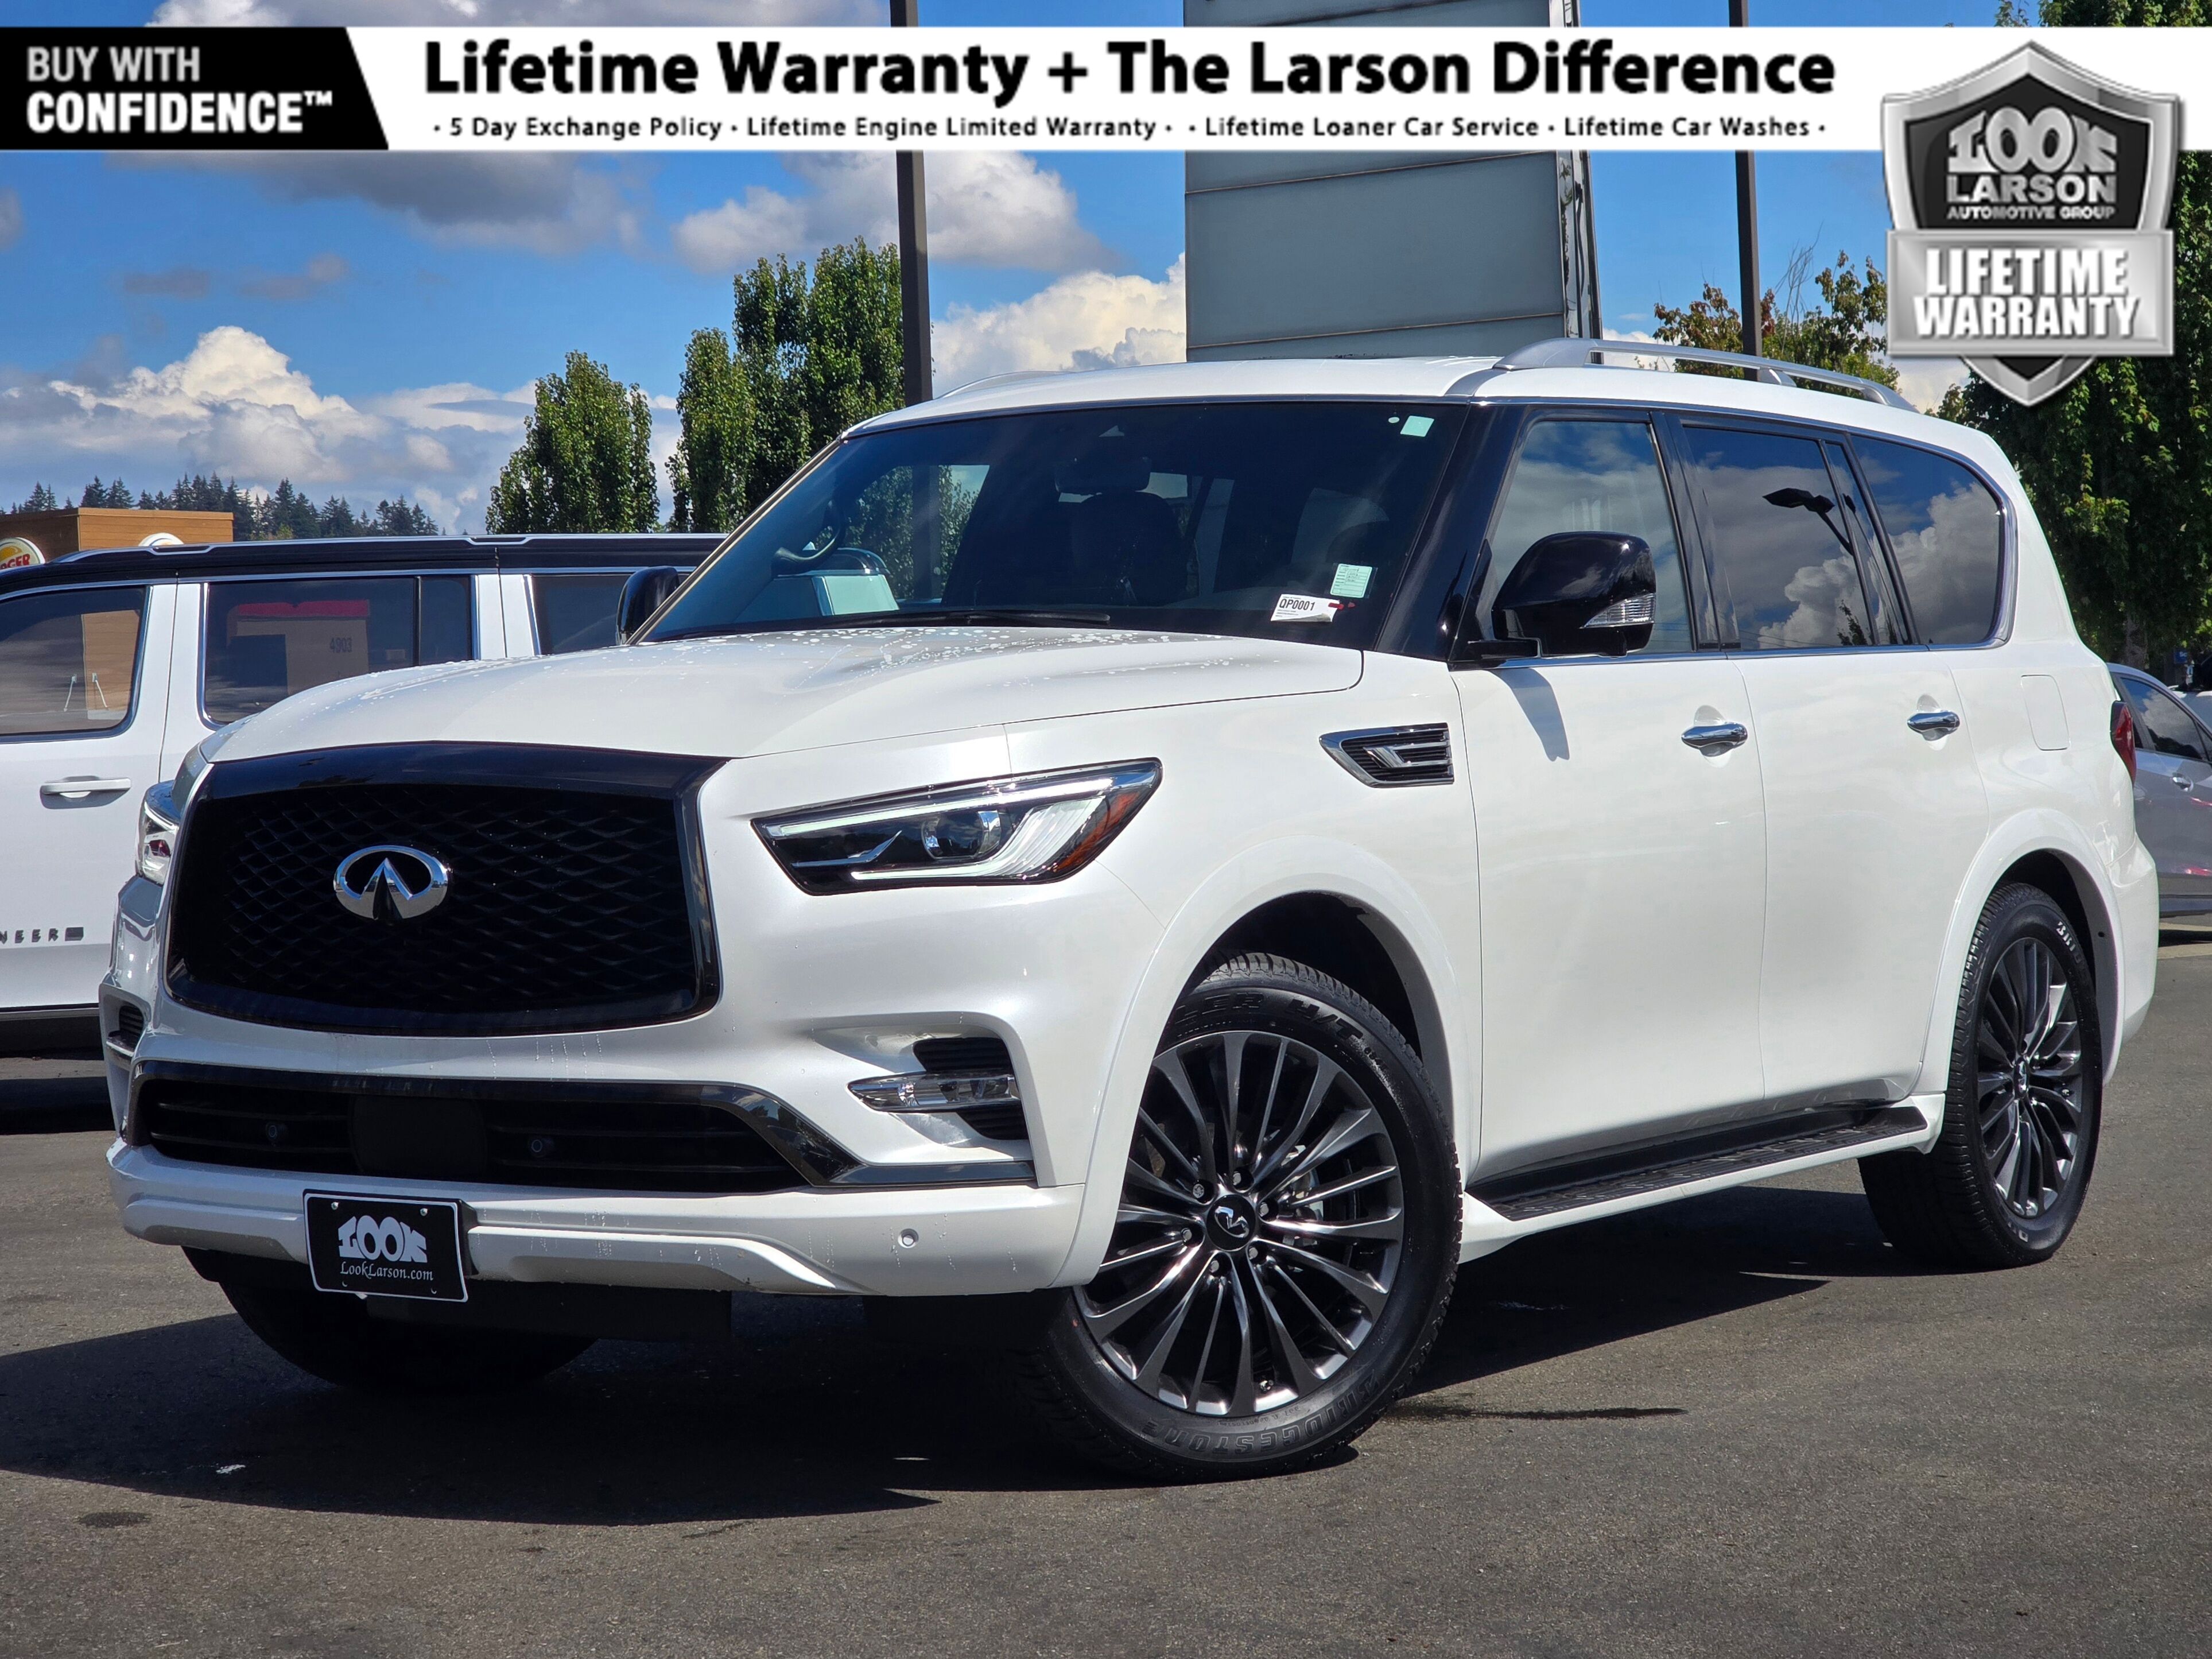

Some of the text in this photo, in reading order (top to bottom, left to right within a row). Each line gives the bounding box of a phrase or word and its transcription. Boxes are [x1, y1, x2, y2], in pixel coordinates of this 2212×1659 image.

[1279, 598, 1315, 611] QP0001
[329, 637, 352, 653] 4903
[338, 1215, 427, 1263] LOOK
[340, 1261, 434, 1281] LookLarson.com
[1139, 1369, 1379, 1455] BRIDGESTONE
